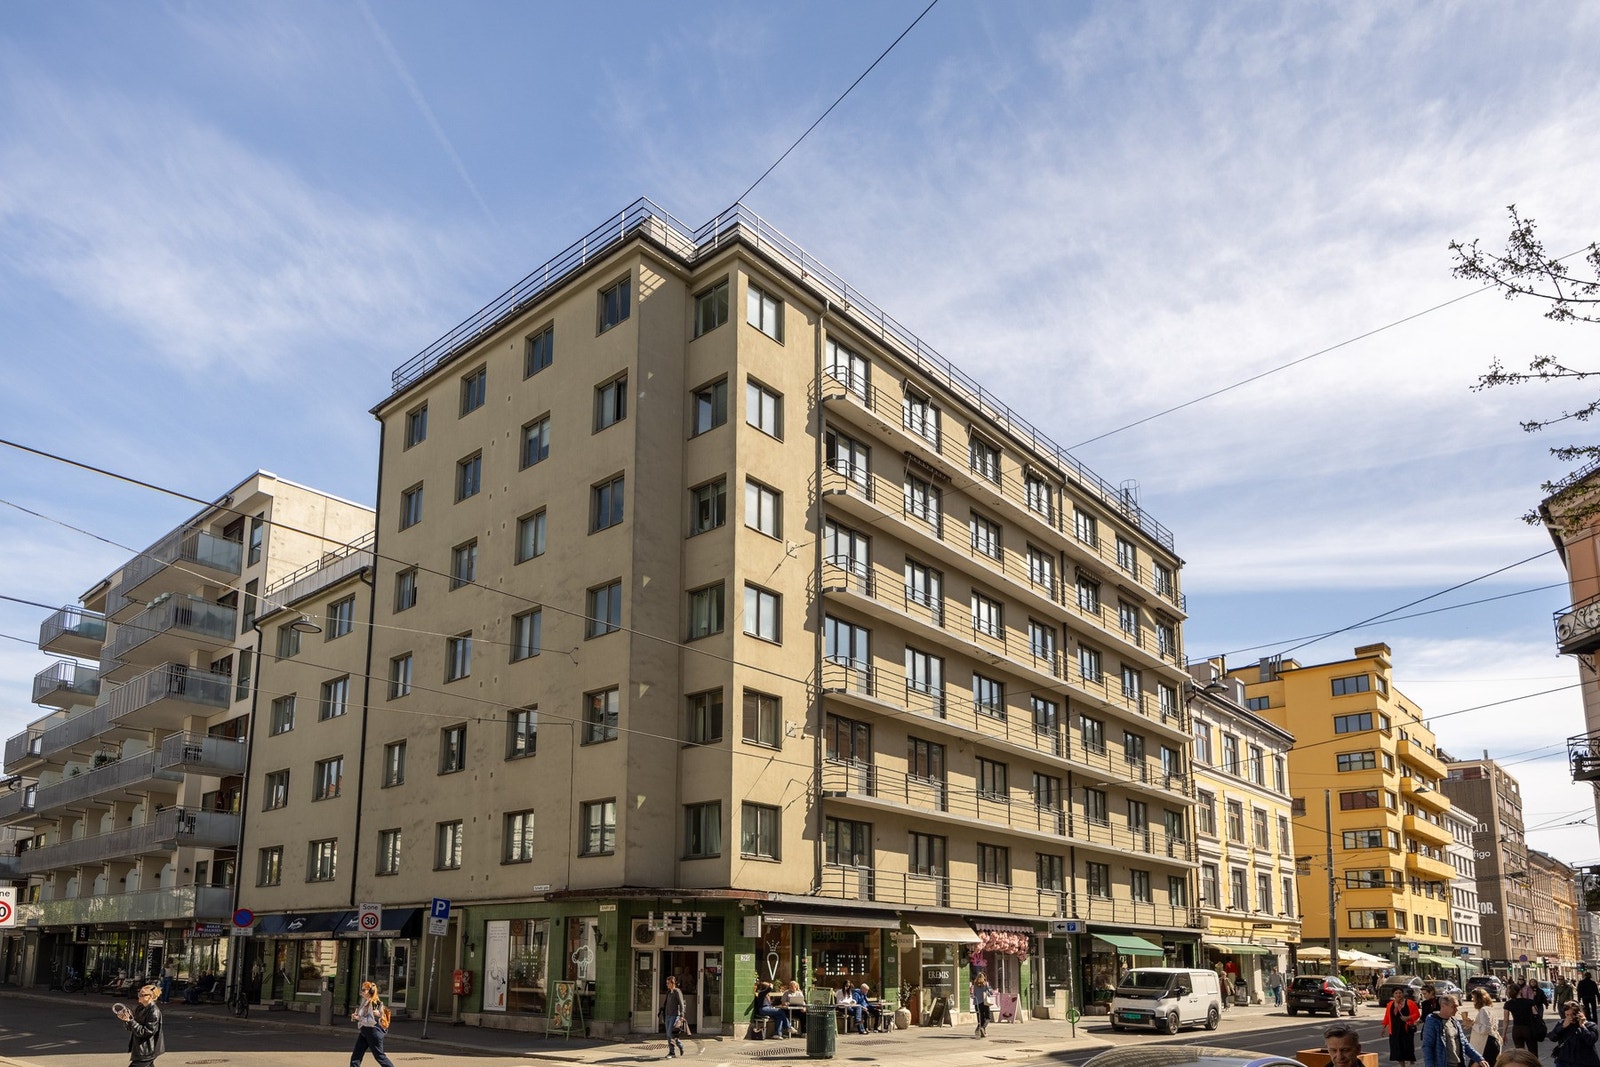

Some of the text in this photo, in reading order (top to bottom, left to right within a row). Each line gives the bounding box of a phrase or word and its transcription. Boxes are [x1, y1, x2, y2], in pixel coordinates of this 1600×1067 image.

[435, 900, 447, 916] P
[364, 916, 376, 926] 30
[648, 911, 707, 932] LETT
[825, 954, 868, 976] LETT
